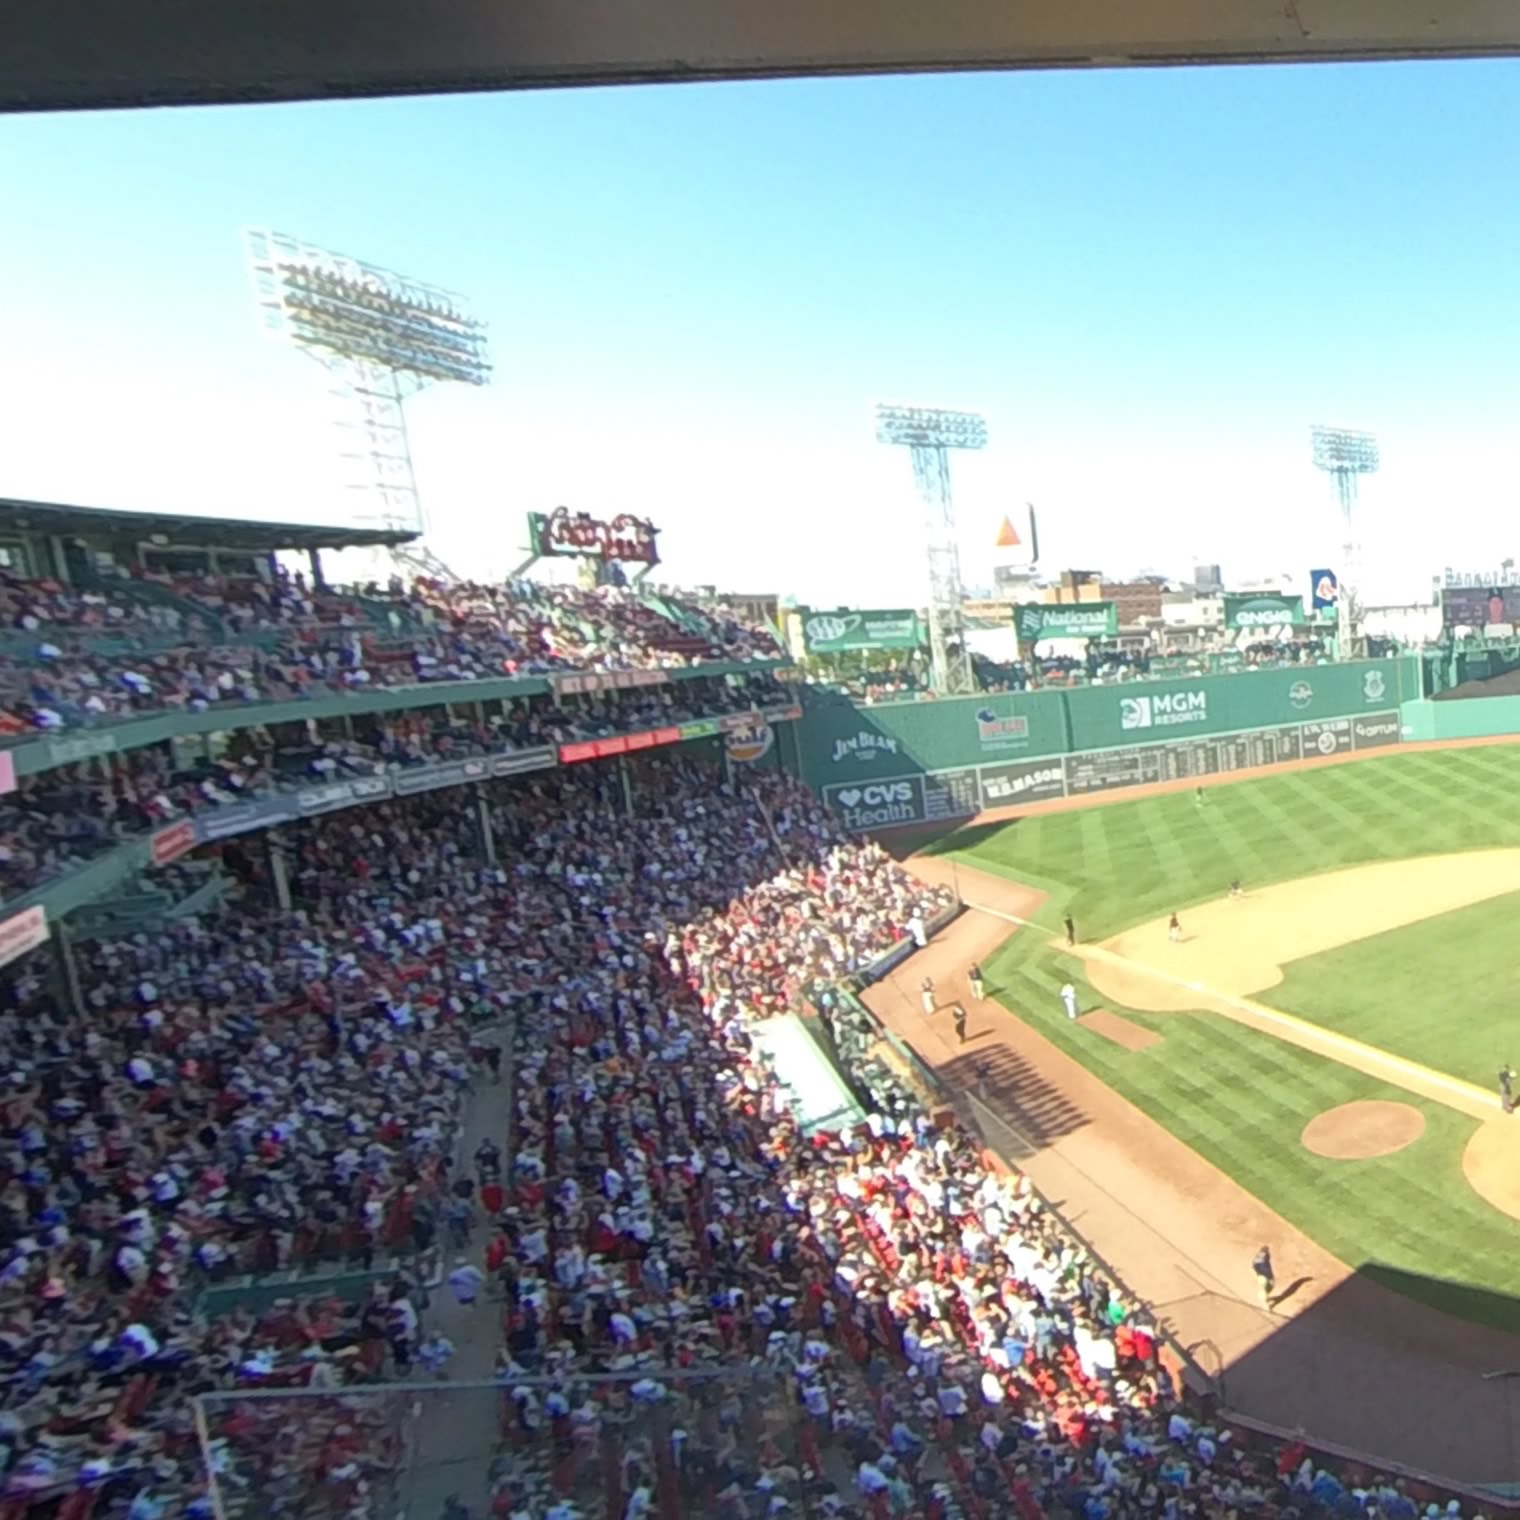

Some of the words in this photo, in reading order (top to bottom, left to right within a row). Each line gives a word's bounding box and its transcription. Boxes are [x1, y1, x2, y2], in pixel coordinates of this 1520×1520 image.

[1042, 608, 1109, 626] National
[1152, 690, 1206, 714] MGM
[1154, 710, 1207, 726] RESORTS
[863, 782, 913, 805] CVS
[843, 803, 915, 828] Health
